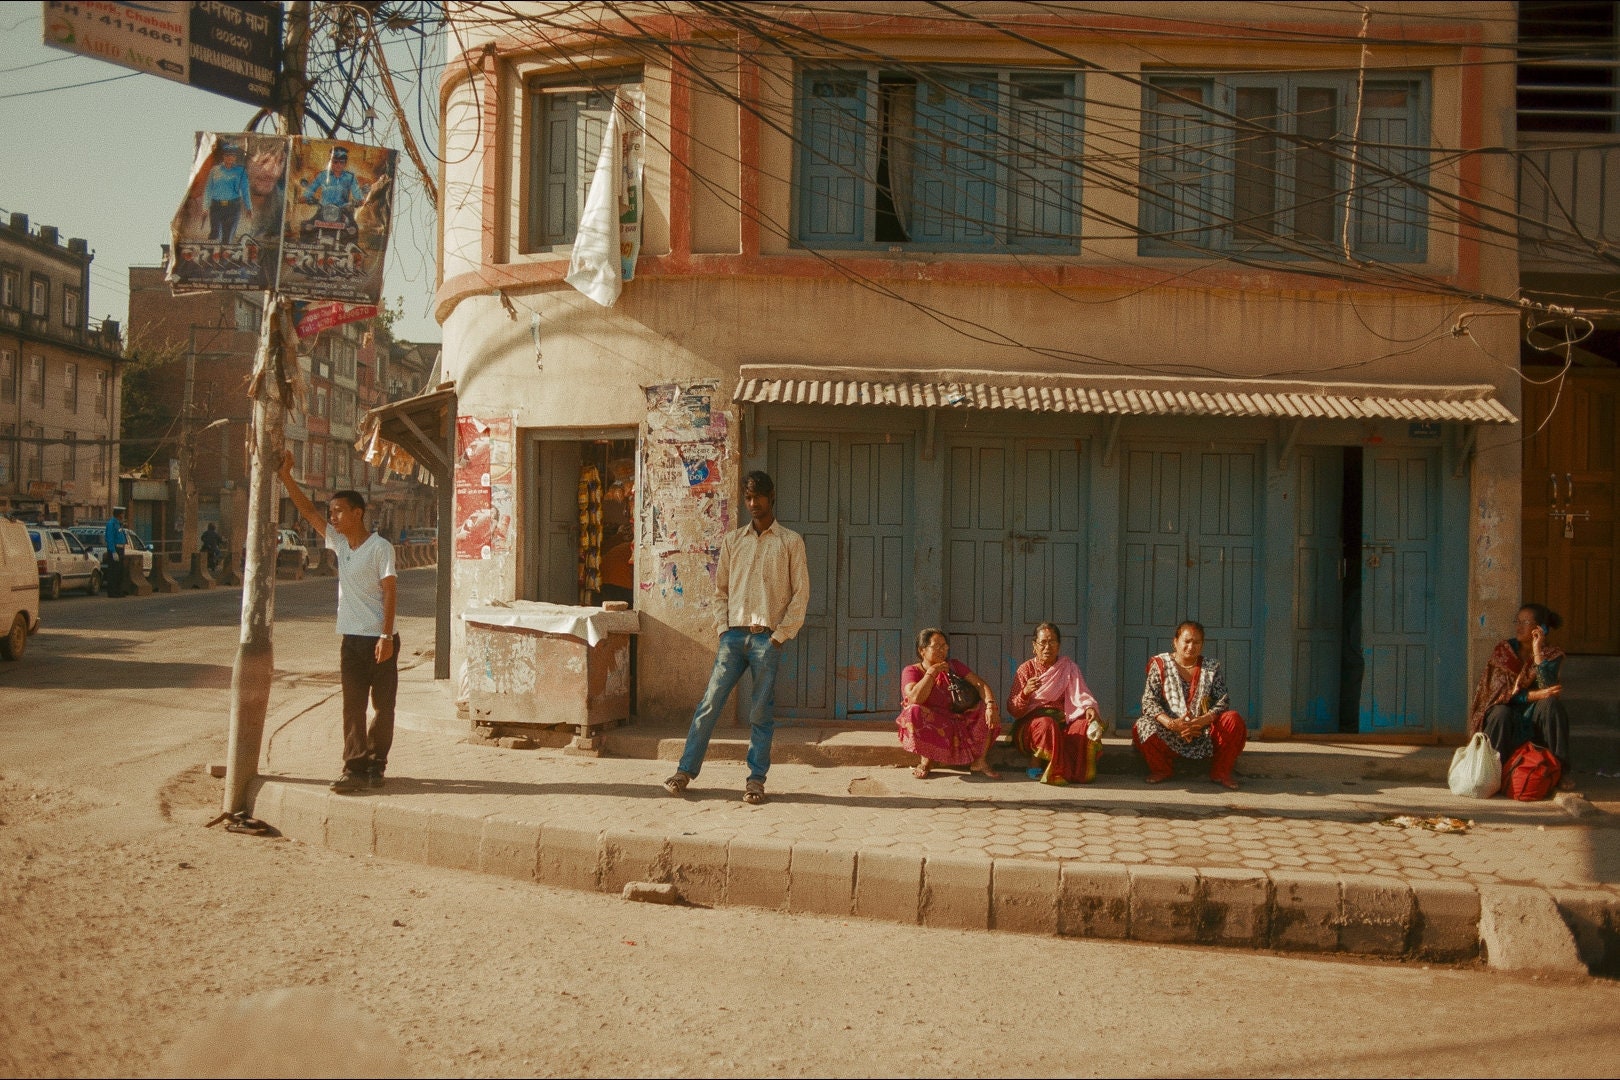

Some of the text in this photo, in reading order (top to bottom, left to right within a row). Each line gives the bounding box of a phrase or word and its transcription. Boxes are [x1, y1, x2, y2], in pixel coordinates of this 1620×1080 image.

[99, 15, 183, 47] 4114661
[125, 9, 183, 34] Chabahil
[81, 34, 121, 58] Auto
